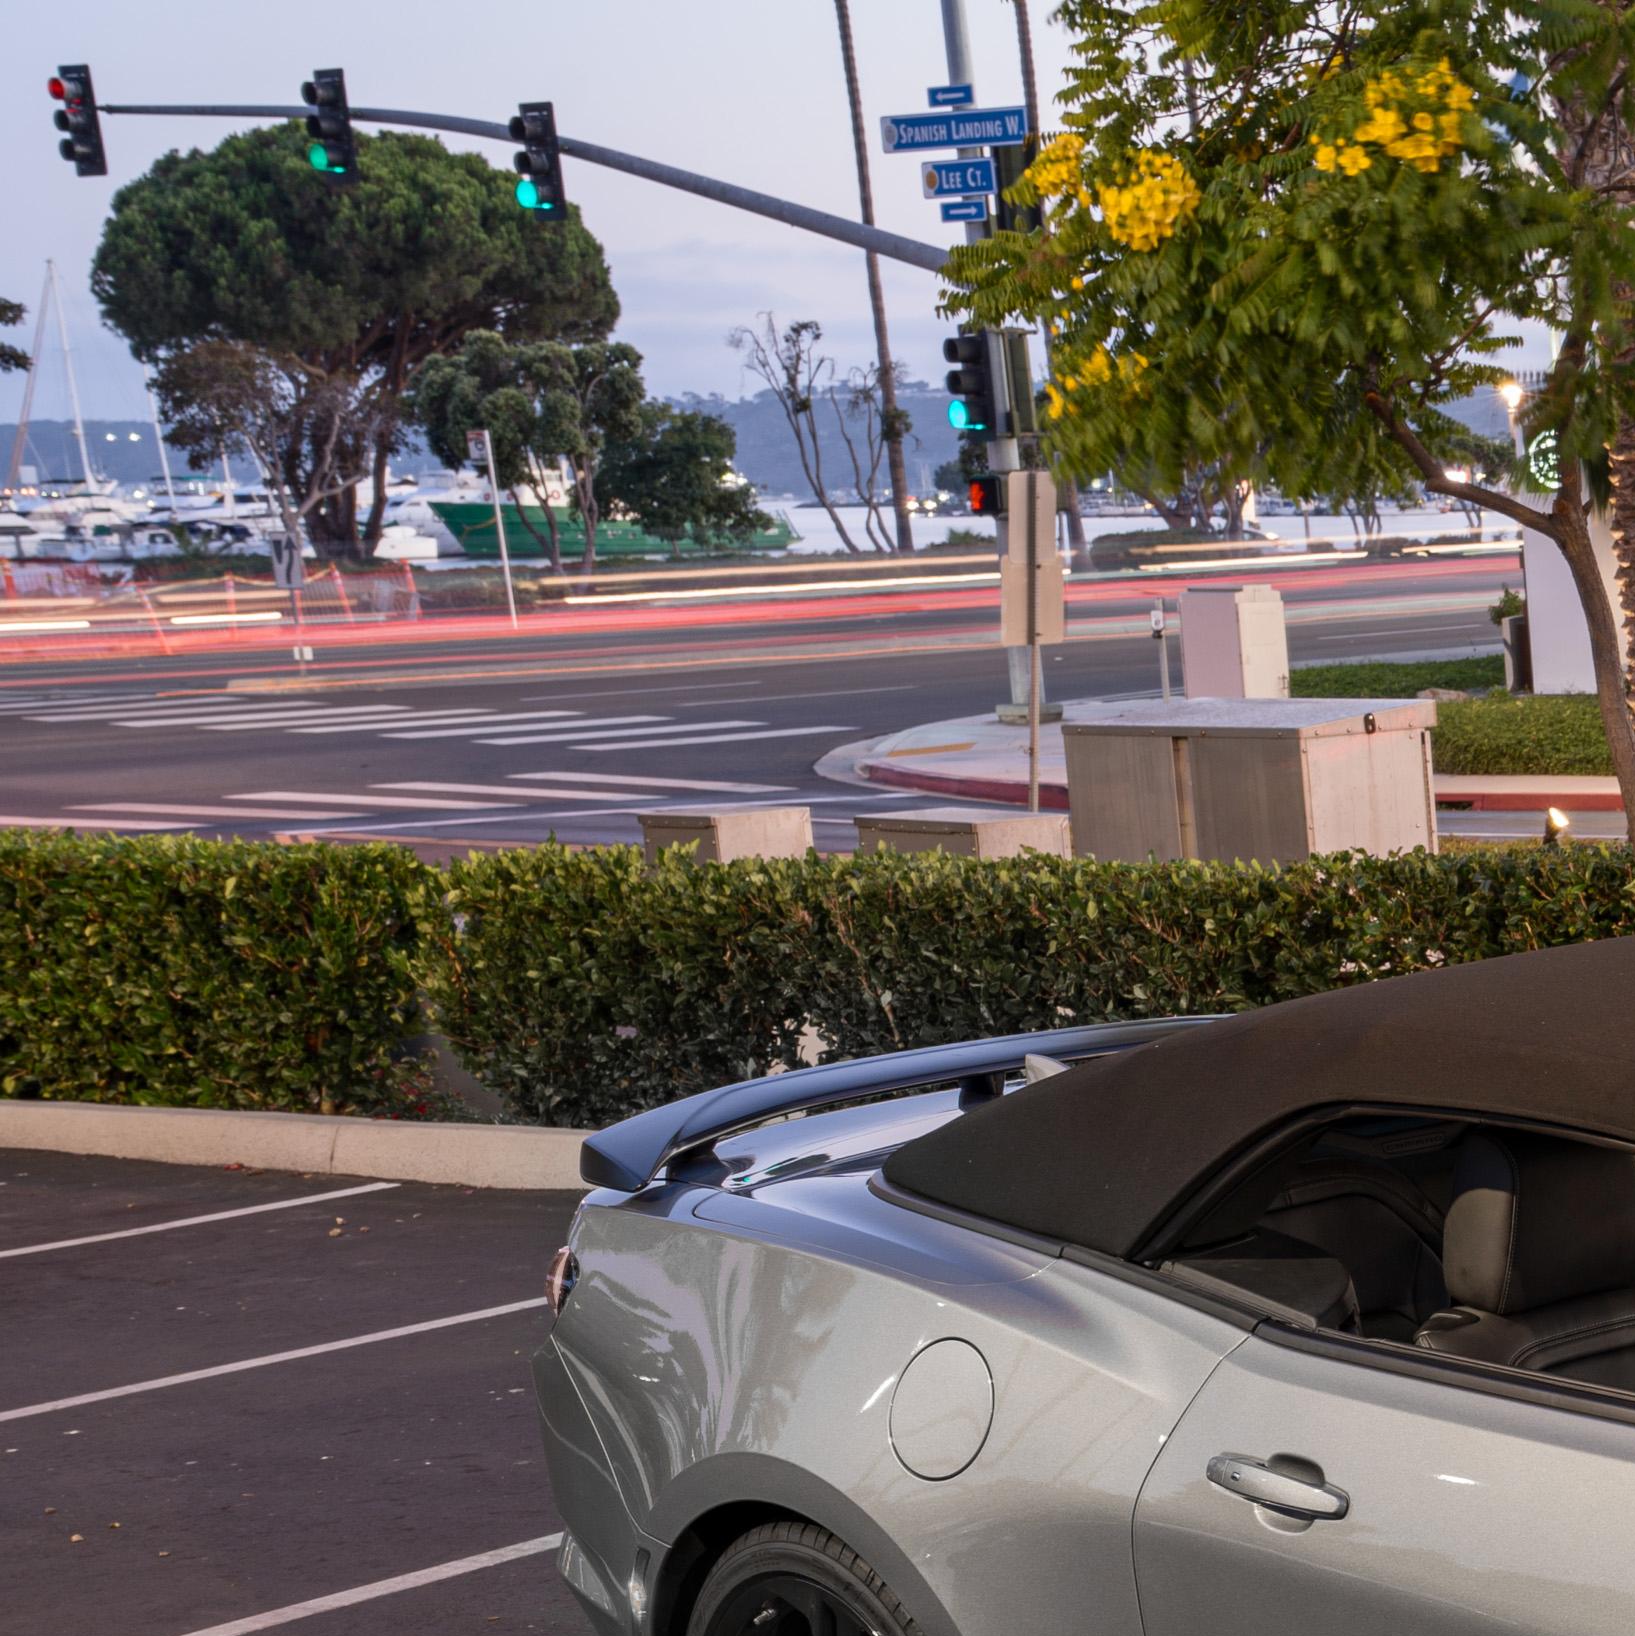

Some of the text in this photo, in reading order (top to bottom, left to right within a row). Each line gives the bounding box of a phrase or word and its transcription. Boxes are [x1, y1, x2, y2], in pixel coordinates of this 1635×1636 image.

[899, 114, 1024, 144] SPANISH LANDING W.
[941, 166, 987, 190] LEE CT.
